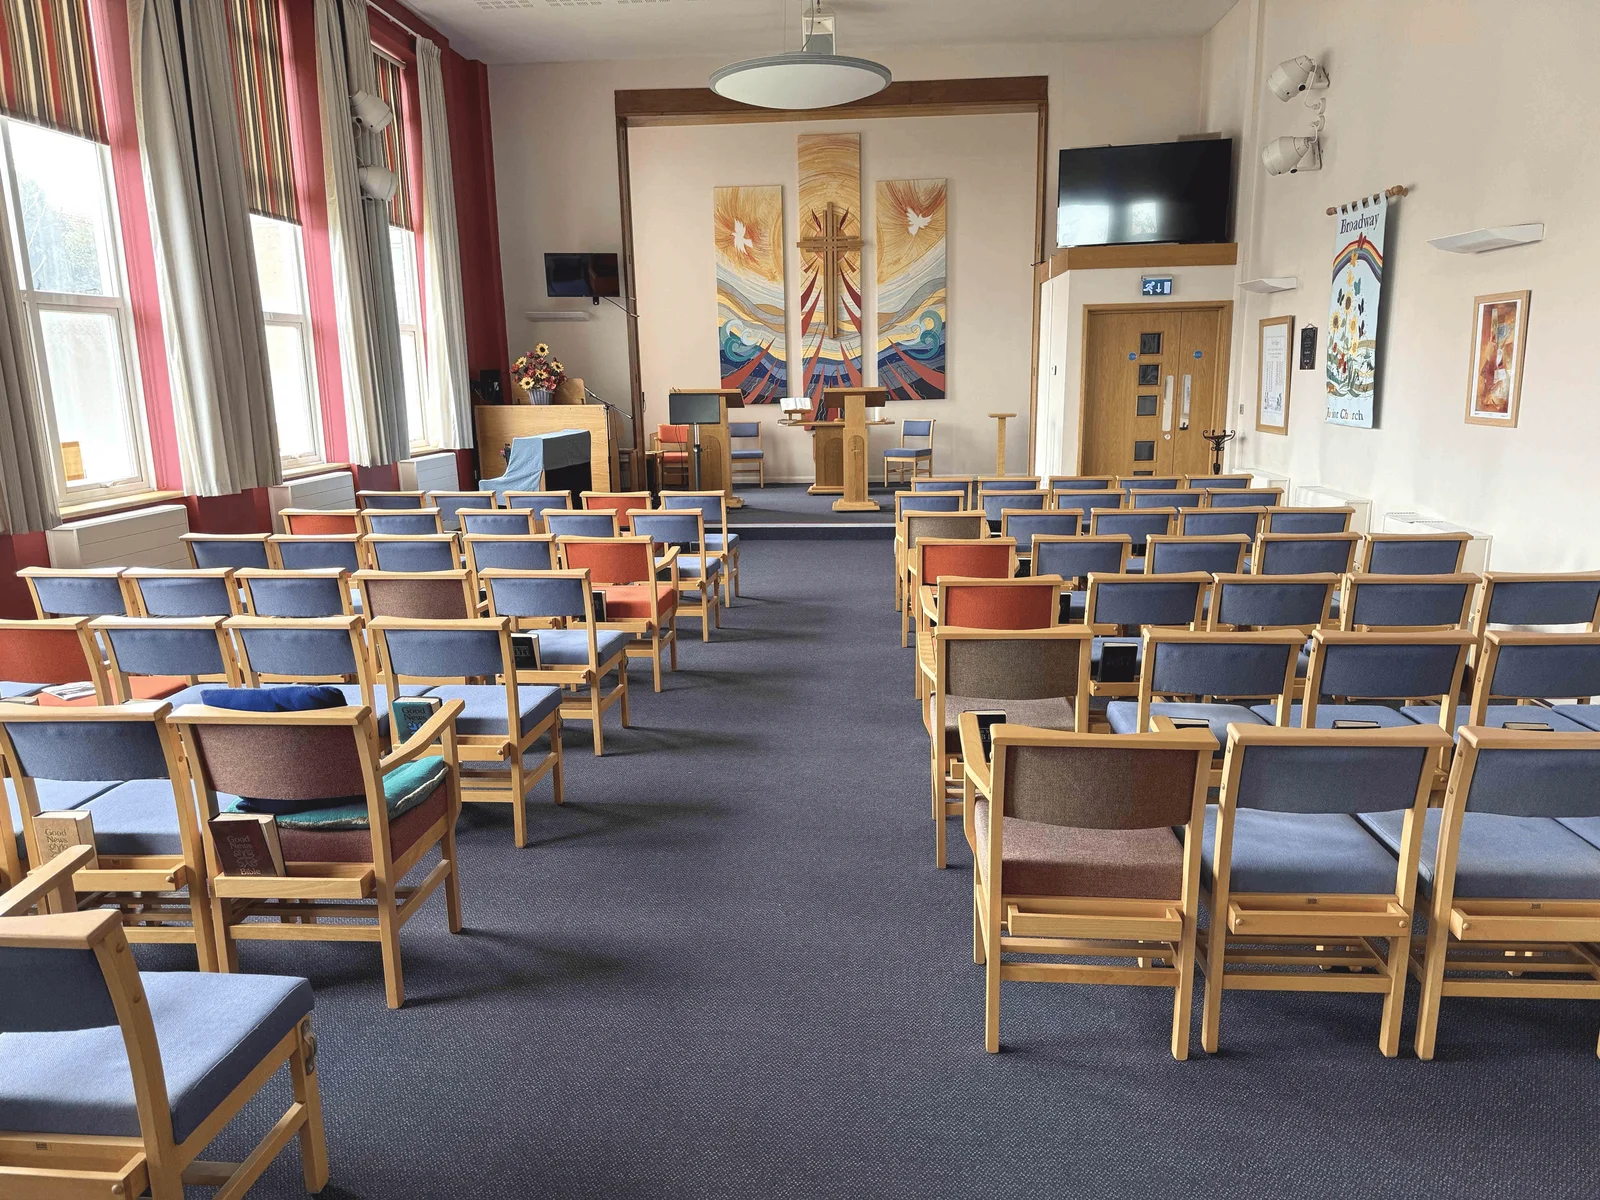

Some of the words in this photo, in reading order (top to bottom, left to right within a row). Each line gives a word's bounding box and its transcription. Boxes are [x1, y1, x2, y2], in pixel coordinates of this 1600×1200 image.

[1340, 213, 1379, 234] Broadway
[1340, 409, 1364, 420] Chrch
[402, 706, 425, 714] Good
[45, 828, 67, 836] Good
[227, 835, 250, 843] Good
[229, 842, 253, 850] News
[240, 868, 261, 876] Bible
